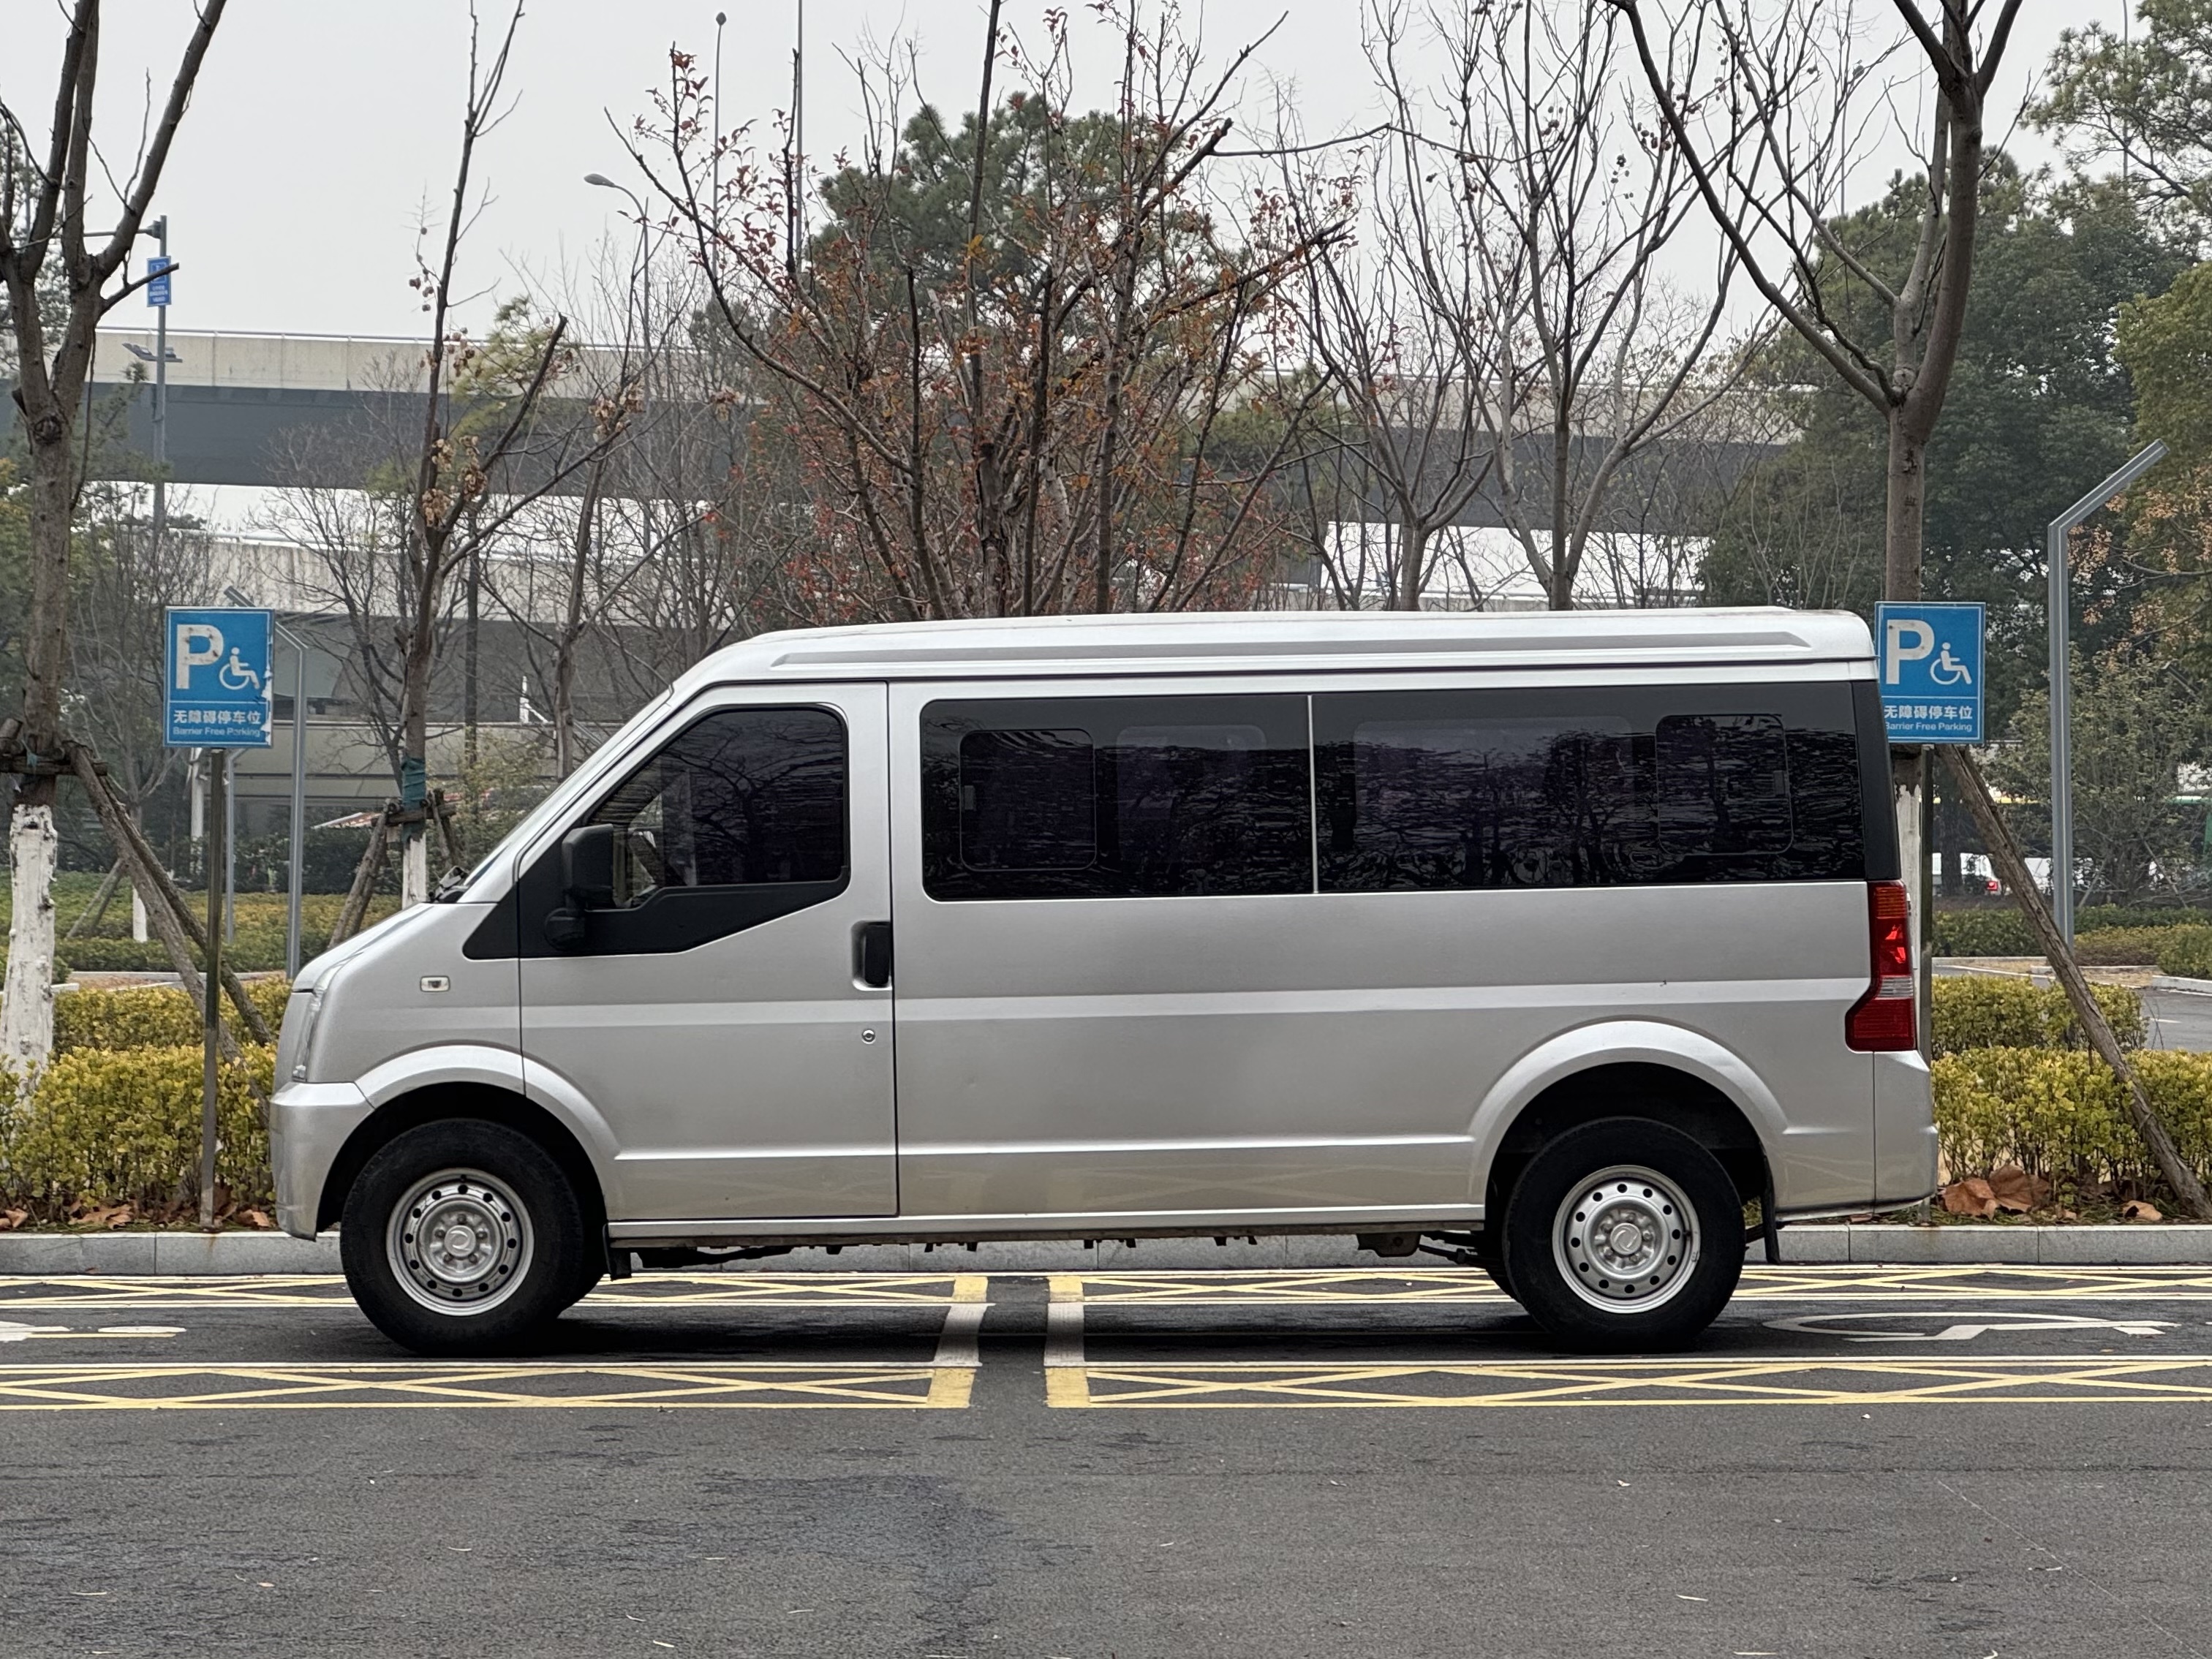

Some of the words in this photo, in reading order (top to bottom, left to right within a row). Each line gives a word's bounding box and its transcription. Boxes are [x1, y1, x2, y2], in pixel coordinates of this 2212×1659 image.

[176, 624, 223, 689] P
[1886, 619, 1934, 684] P
[173, 710, 262, 724] 无障碍停车位
[1884, 705, 1973, 719] 无障碍停车位
[173, 727, 203, 735] Barrier
[205, 727, 225, 735] Free
[227, 728, 260, 737] Parking
[1916, 722, 1936, 730] Free
[1939, 722, 1972, 732] Parking
